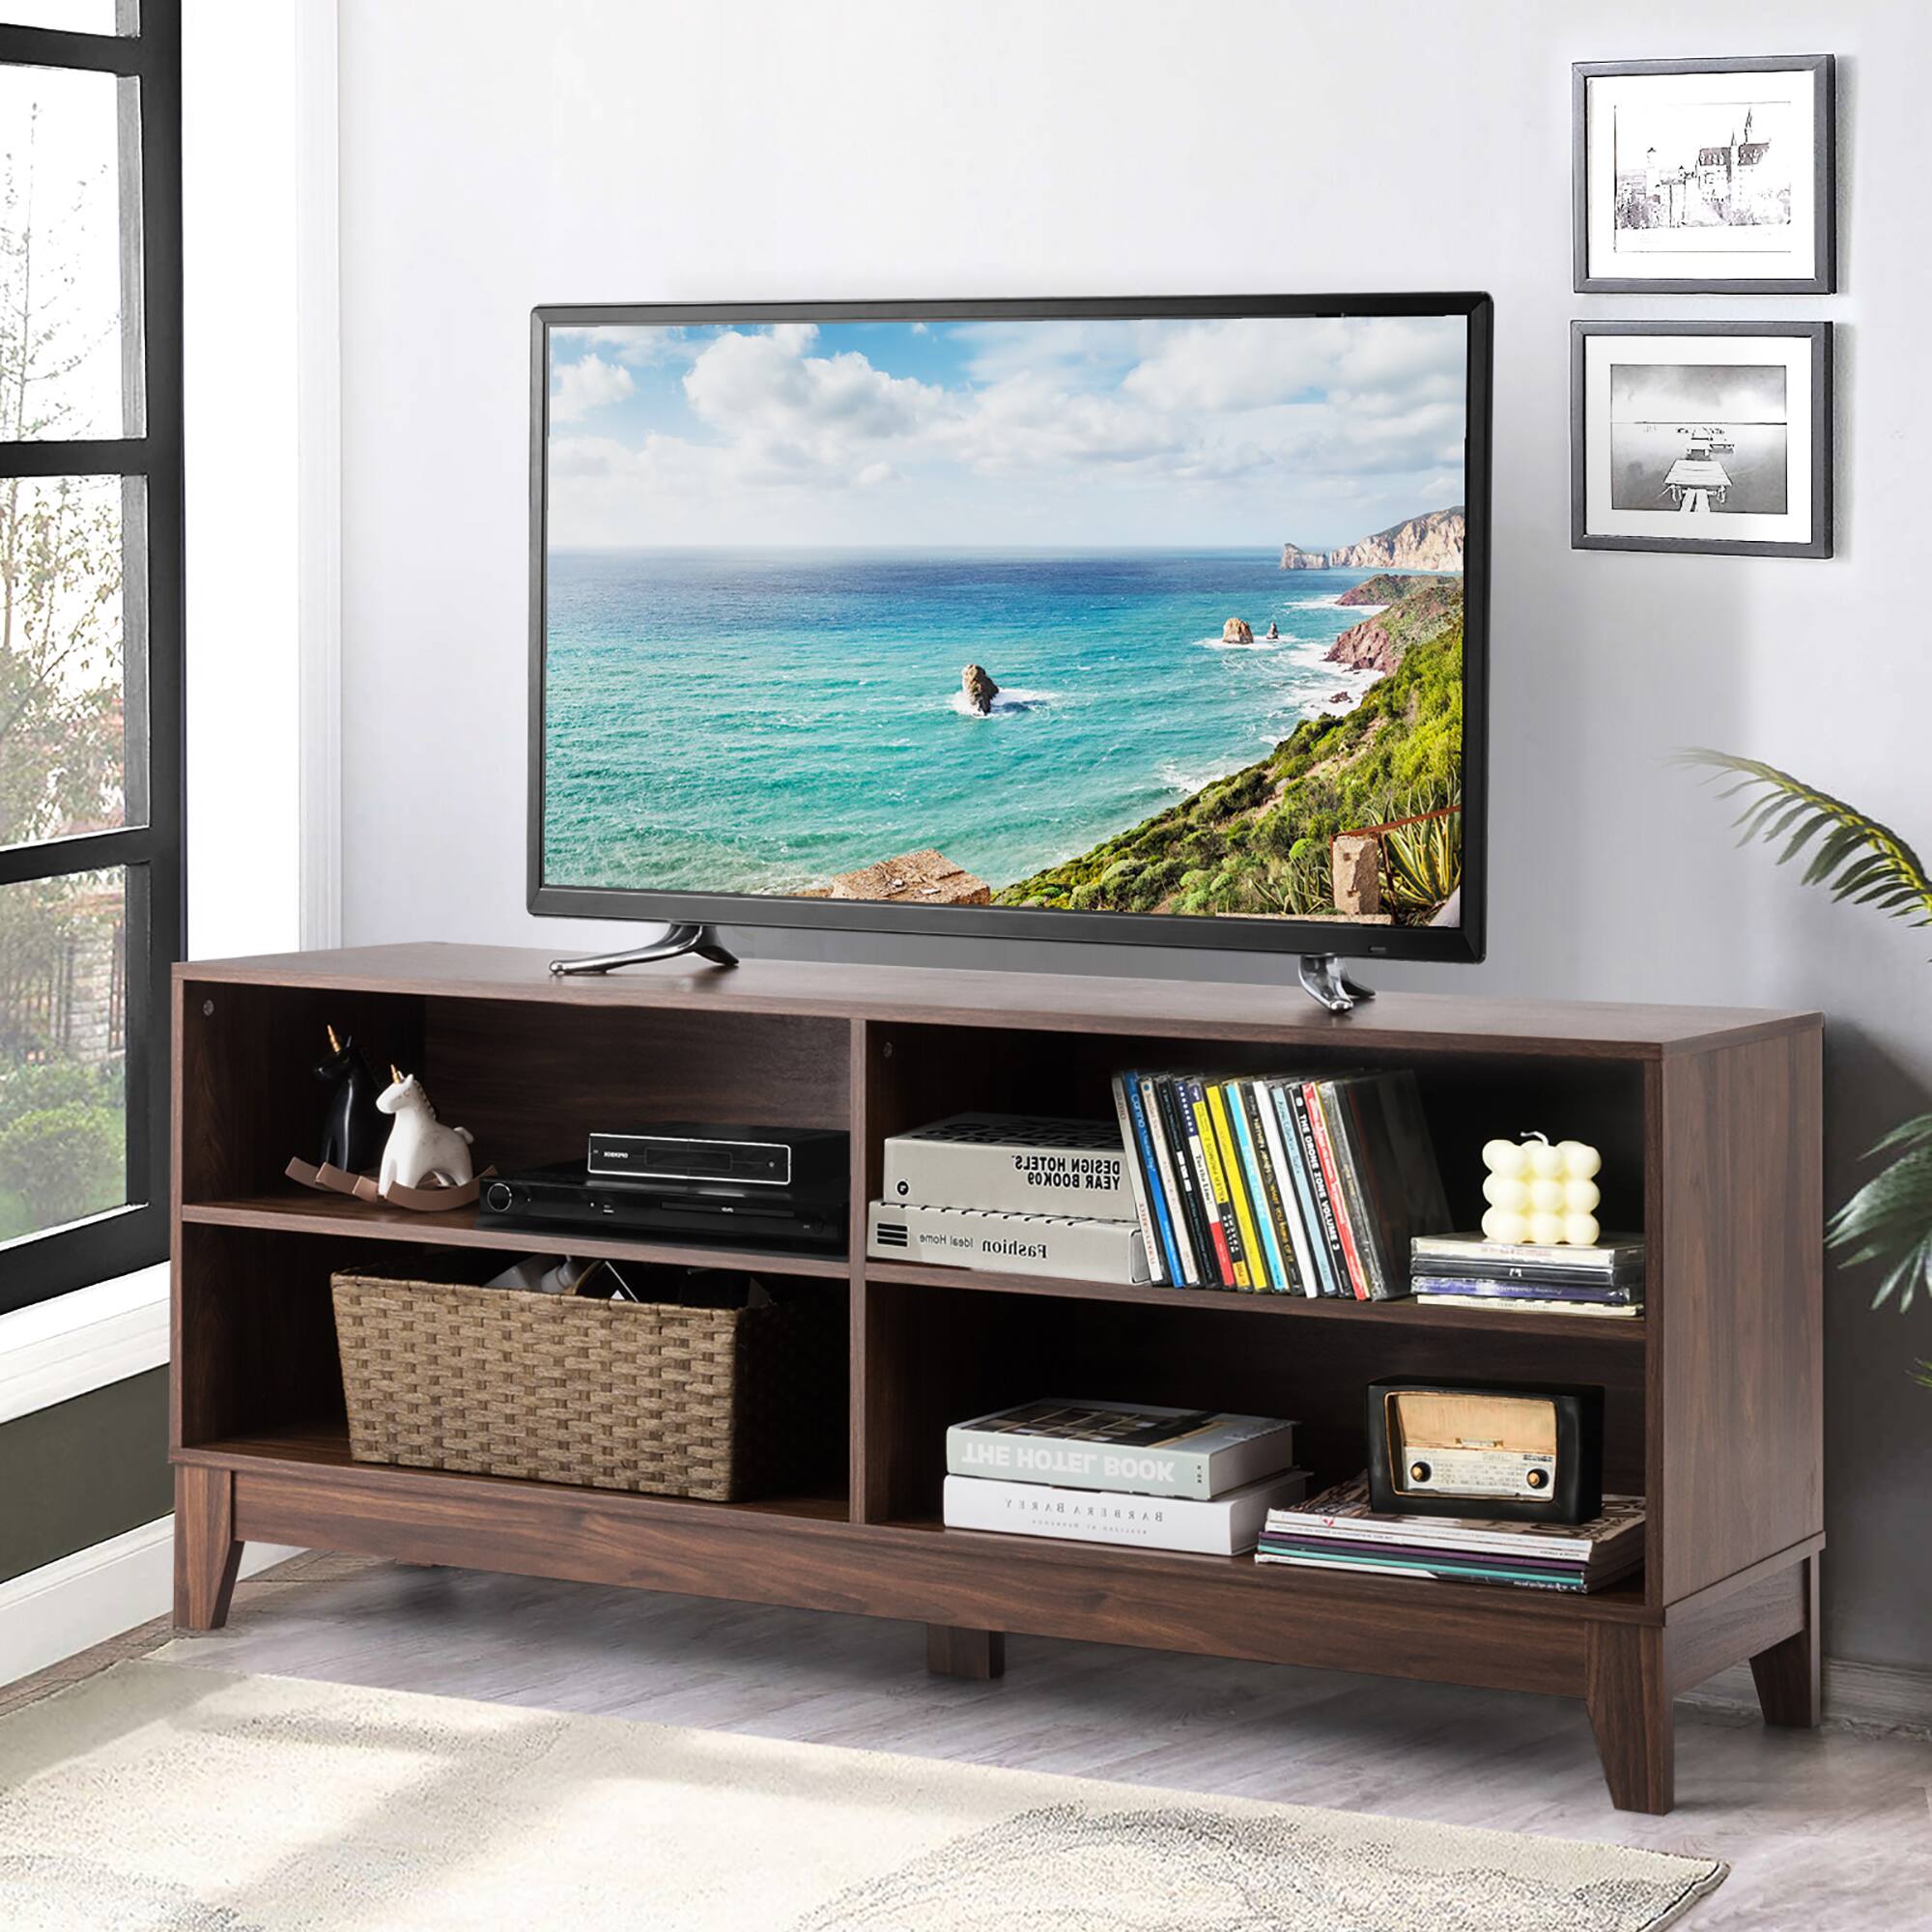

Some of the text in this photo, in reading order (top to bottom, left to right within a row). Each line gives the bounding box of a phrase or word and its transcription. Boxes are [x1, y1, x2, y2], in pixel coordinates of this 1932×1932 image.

[1298, 1113, 1310, 1133] THE
[1304, 1135, 1319, 1169] DRONE
[1313, 1171, 1326, 1199] ZONE
[1321, 1201, 1337, 1242] VOLUME
